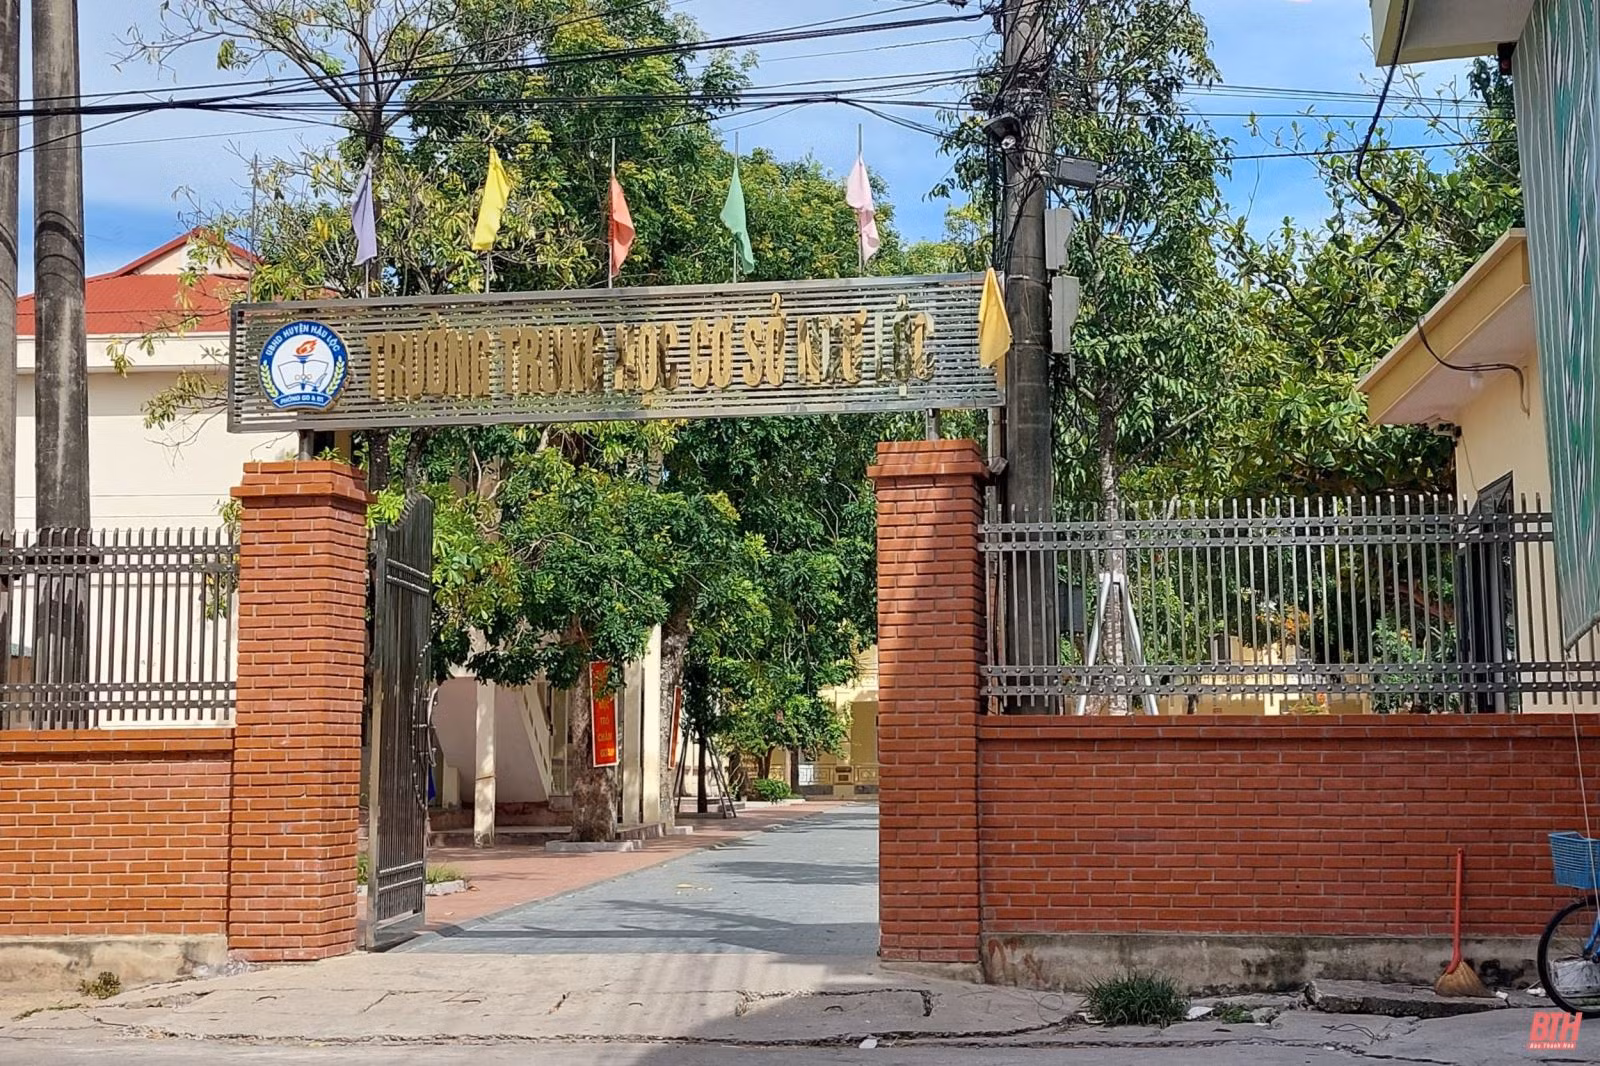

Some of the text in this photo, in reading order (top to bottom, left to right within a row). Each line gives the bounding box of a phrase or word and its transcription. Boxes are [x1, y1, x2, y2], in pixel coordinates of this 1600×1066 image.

[283, 322, 309, 338] HUYỆN
[326, 334, 341, 352] LỘC
[366, 311, 491, 399] TRƯỜNG
[501, 323, 604, 394] TRUNG
[614, 322, 678, 406] HỌC
[690, 313, 732, 388] CƠ
[743, 292, 786, 387] SỞ
